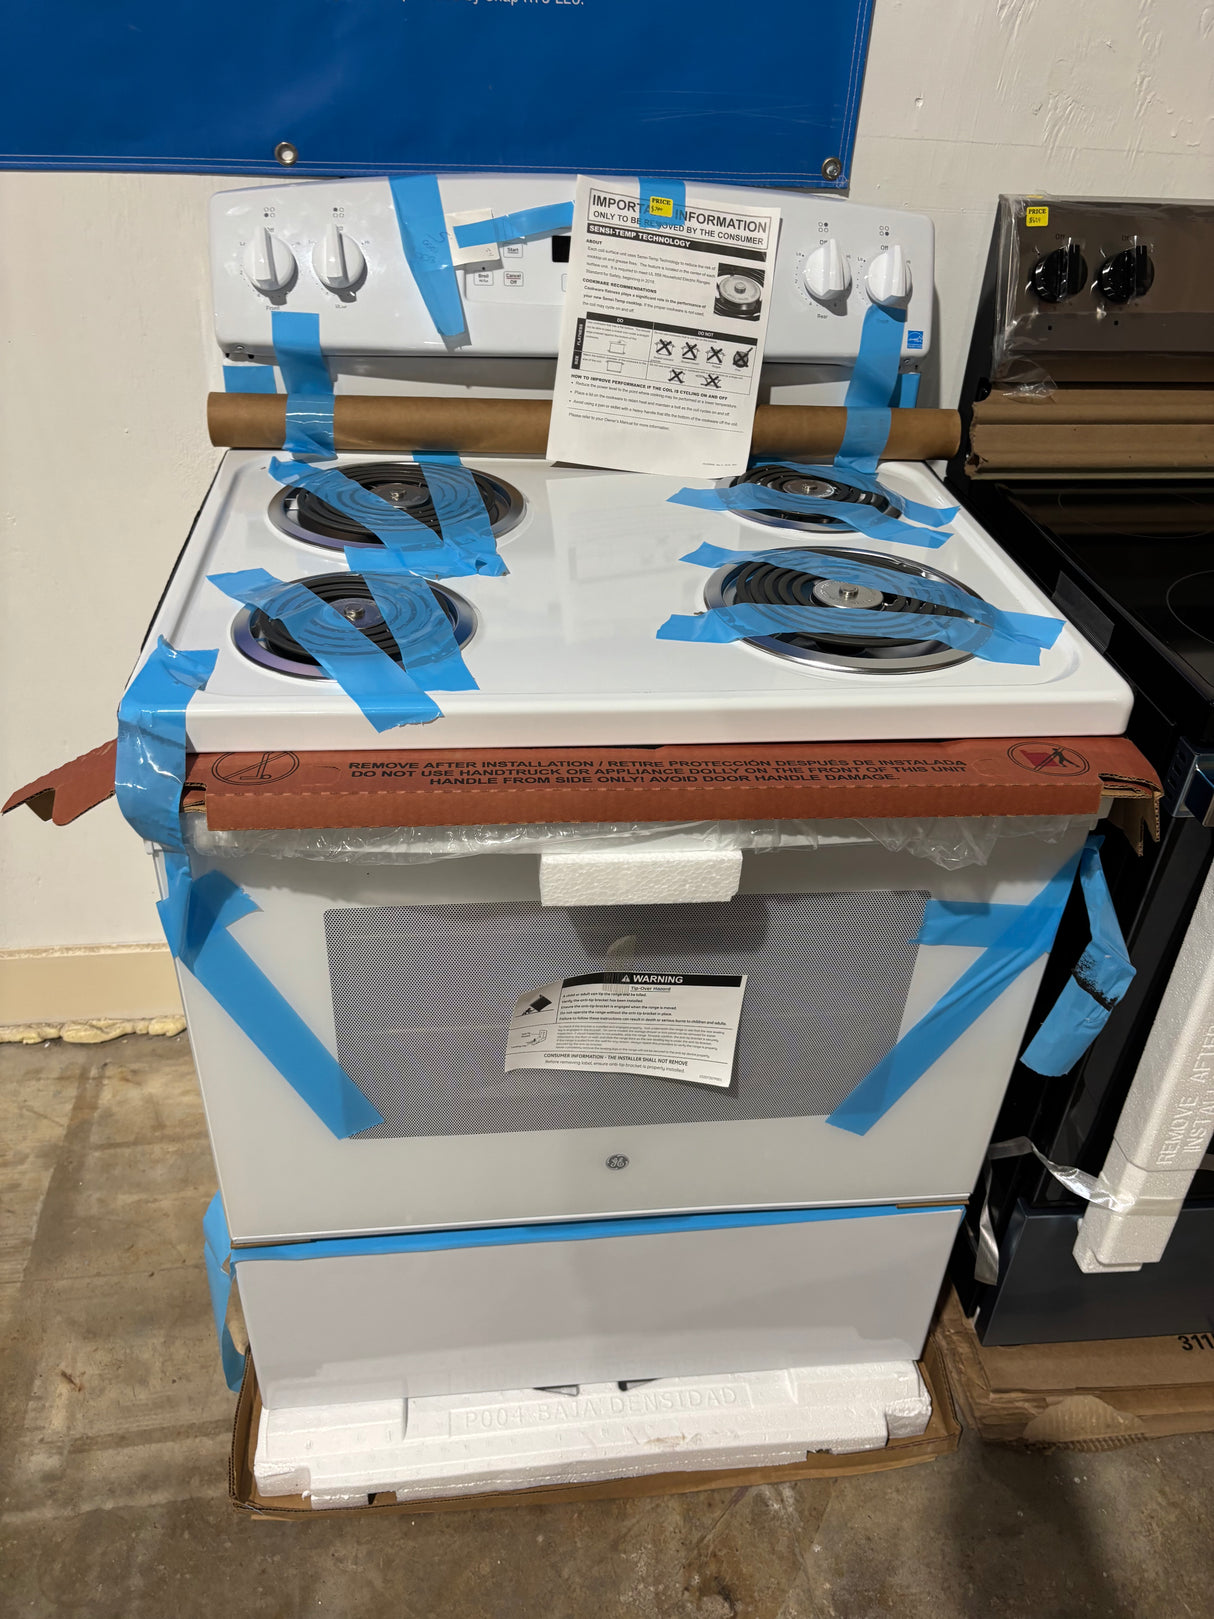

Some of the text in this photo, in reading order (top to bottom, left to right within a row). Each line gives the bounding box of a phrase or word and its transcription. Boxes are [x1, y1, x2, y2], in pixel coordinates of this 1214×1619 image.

[651, 197, 671, 205] PRICE
[593, 211, 763, 245] ONLY TO BE REMOVED BY THE CONSUMER
[675, 208, 766, 233] INFORMATION
[589, 225, 690, 248] SENSI-TEMP TECHNOLOGY
[611, 379, 645, 388] PERFORMANCE
[669, 759, 771, 767] PROTECCIÓN
[777, 758, 848, 767] DESPUÉS
[633, 974, 683, 984] WARNING
[1156, 1095, 1200, 1165] REMOVE
[1178, 1332, 1214, 1350] 311
[610, 1386, 737, 1413] DENSIDAD
